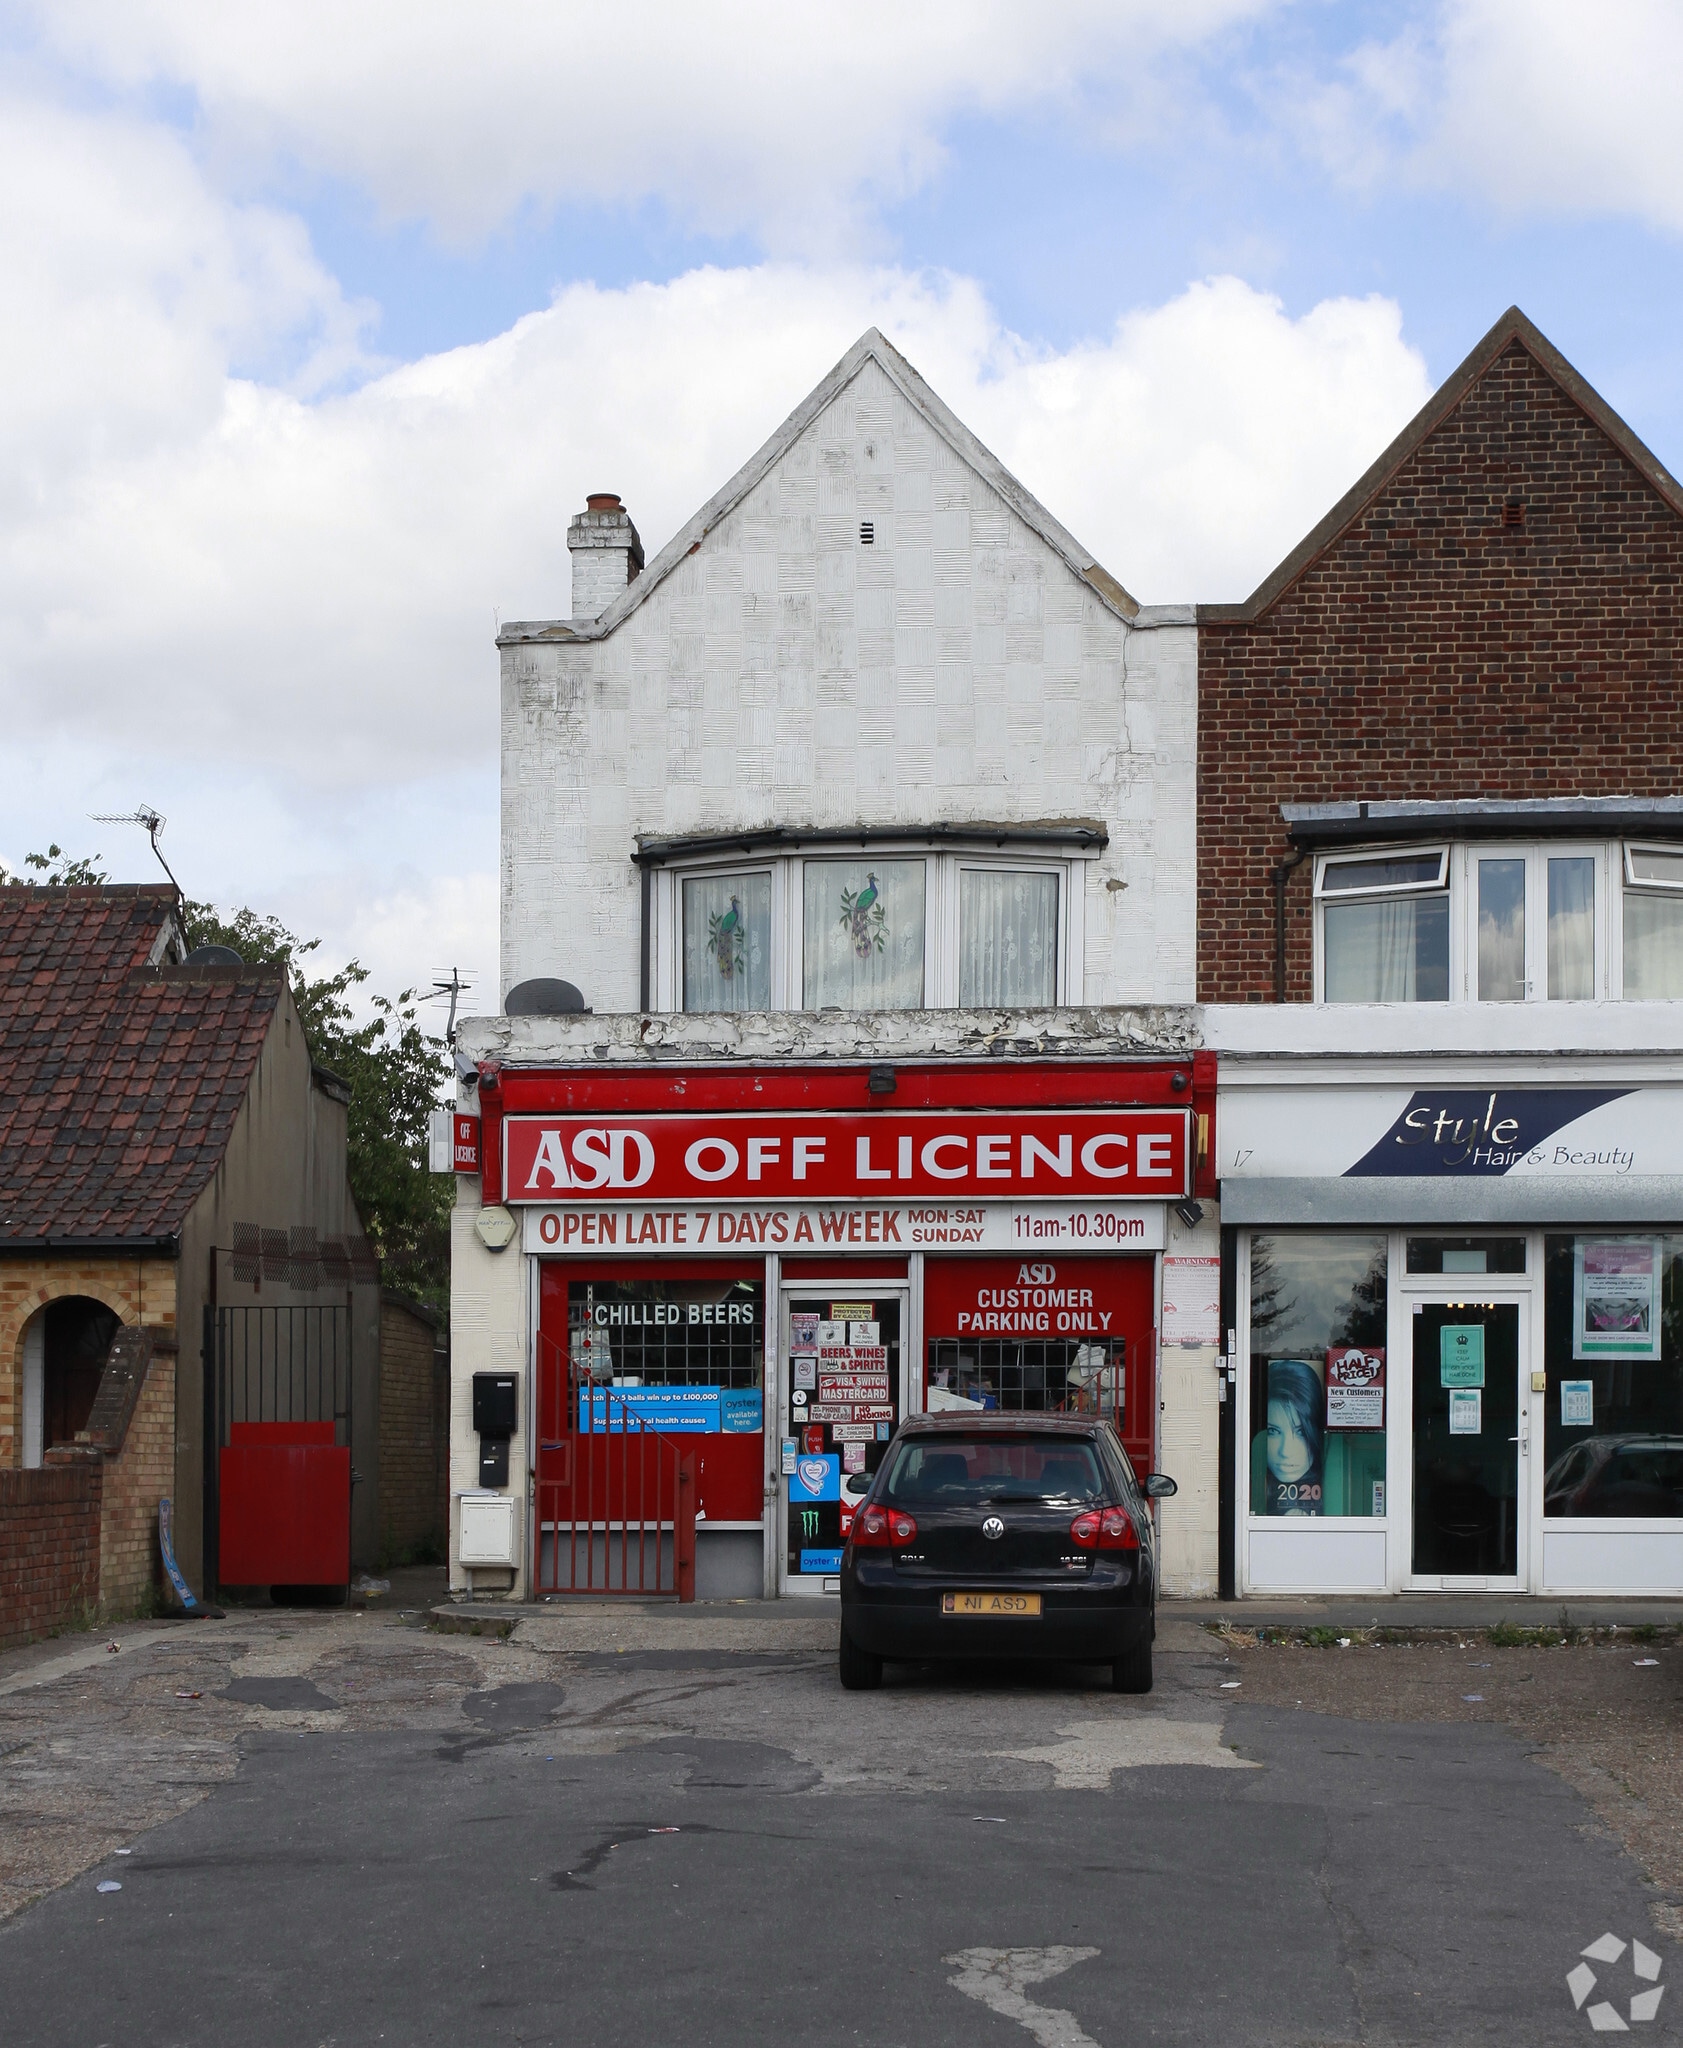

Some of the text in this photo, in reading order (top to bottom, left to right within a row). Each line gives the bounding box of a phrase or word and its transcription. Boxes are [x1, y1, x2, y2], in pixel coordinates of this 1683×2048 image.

[460, 1122, 471, 1139] OFF
[1396, 1092, 1519, 1166] Style
[454, 1145, 477, 1163] LICENCE
[524, 1129, 1172, 1190] ASD OFF LICENCE
[1234, 1149, 1254, 1168] 17
[1473, 1146, 1635, 1174] Hair & Beauty
[908, 1209, 987, 1224] MON-SAT
[539, 1210, 902, 1245] OPEN LATE 7 DAYS A WEEK
[1014, 1213, 1145, 1243] 11am-10.30pm
[911, 1228, 985, 1243] SUNDAY
[1016, 1264, 1056, 1285] ASD
[977, 1288, 1093, 1308] CUSTOMER
[595, 1303, 754, 1326] CHILLED BEERS
[957, 1311, 1112, 1331] PARKING ONLY
[854, 1347, 885, 1358] WINES
[840, 1360, 885, 1370] & SPIRITS
[1336, 1355, 1375, 1371] HALF
[1337, 1366, 1375, 1381] PRICE!
[856, 1377, 886, 1386] SWITCH
[683, 1393, 718, 1402] £100,000
[822, 1388, 886, 1399] MASTERCARD
[1330, 1388, 1381, 1396] New Customers
[725, 1401, 757, 1409] oyster
[858, 1405, 871, 1414] NO
[727, 1411, 758, 1419] available
[855, 1409, 891, 1421] SMOKING
[837, 1428, 844, 1436] 2
[1277, 1484, 1322, 1500] 2020
[803, 1557, 830, 1566] oyster
[990, 1596, 1027, 1610] ASD
